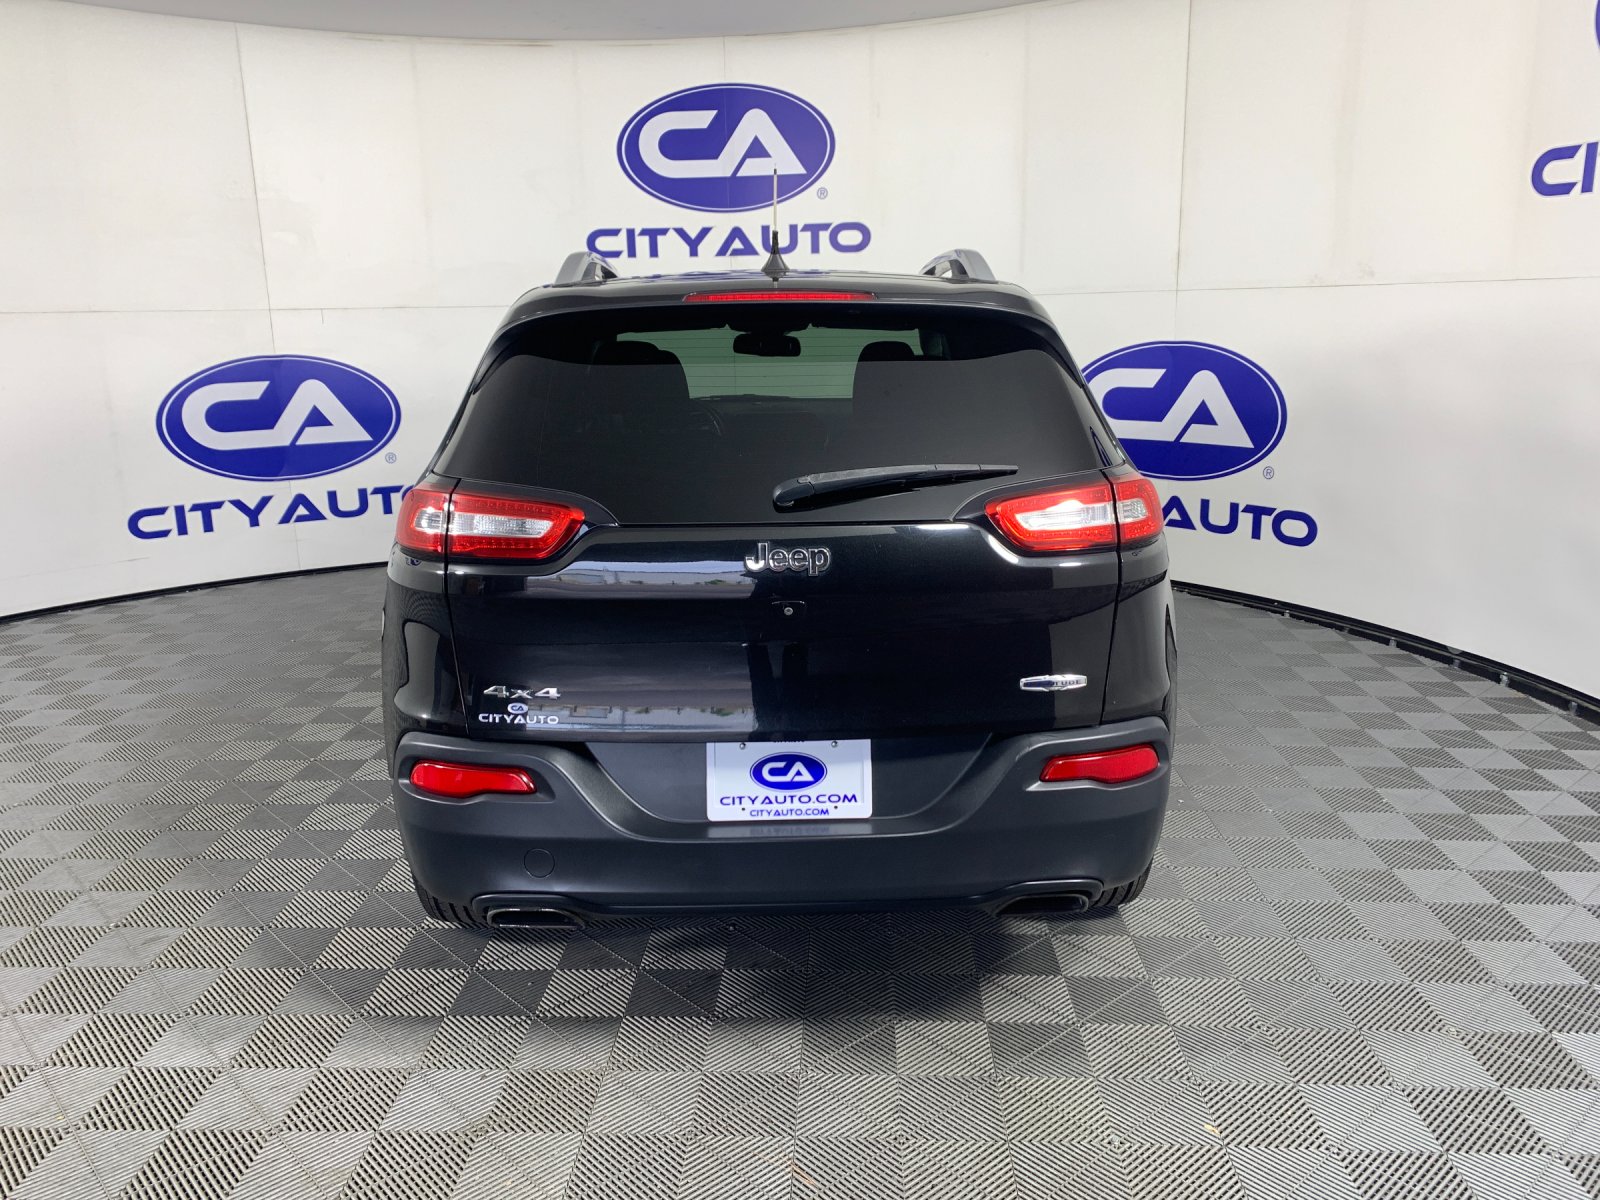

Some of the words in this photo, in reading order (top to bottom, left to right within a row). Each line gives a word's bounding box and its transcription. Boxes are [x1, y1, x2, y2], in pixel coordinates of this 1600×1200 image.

[638, 108, 808, 179] CA
[181, 378, 374, 451] CA
[1088, 367, 1255, 449] CA
[744, 541, 831, 576] Jeep
[761, 761, 815, 783] CA
